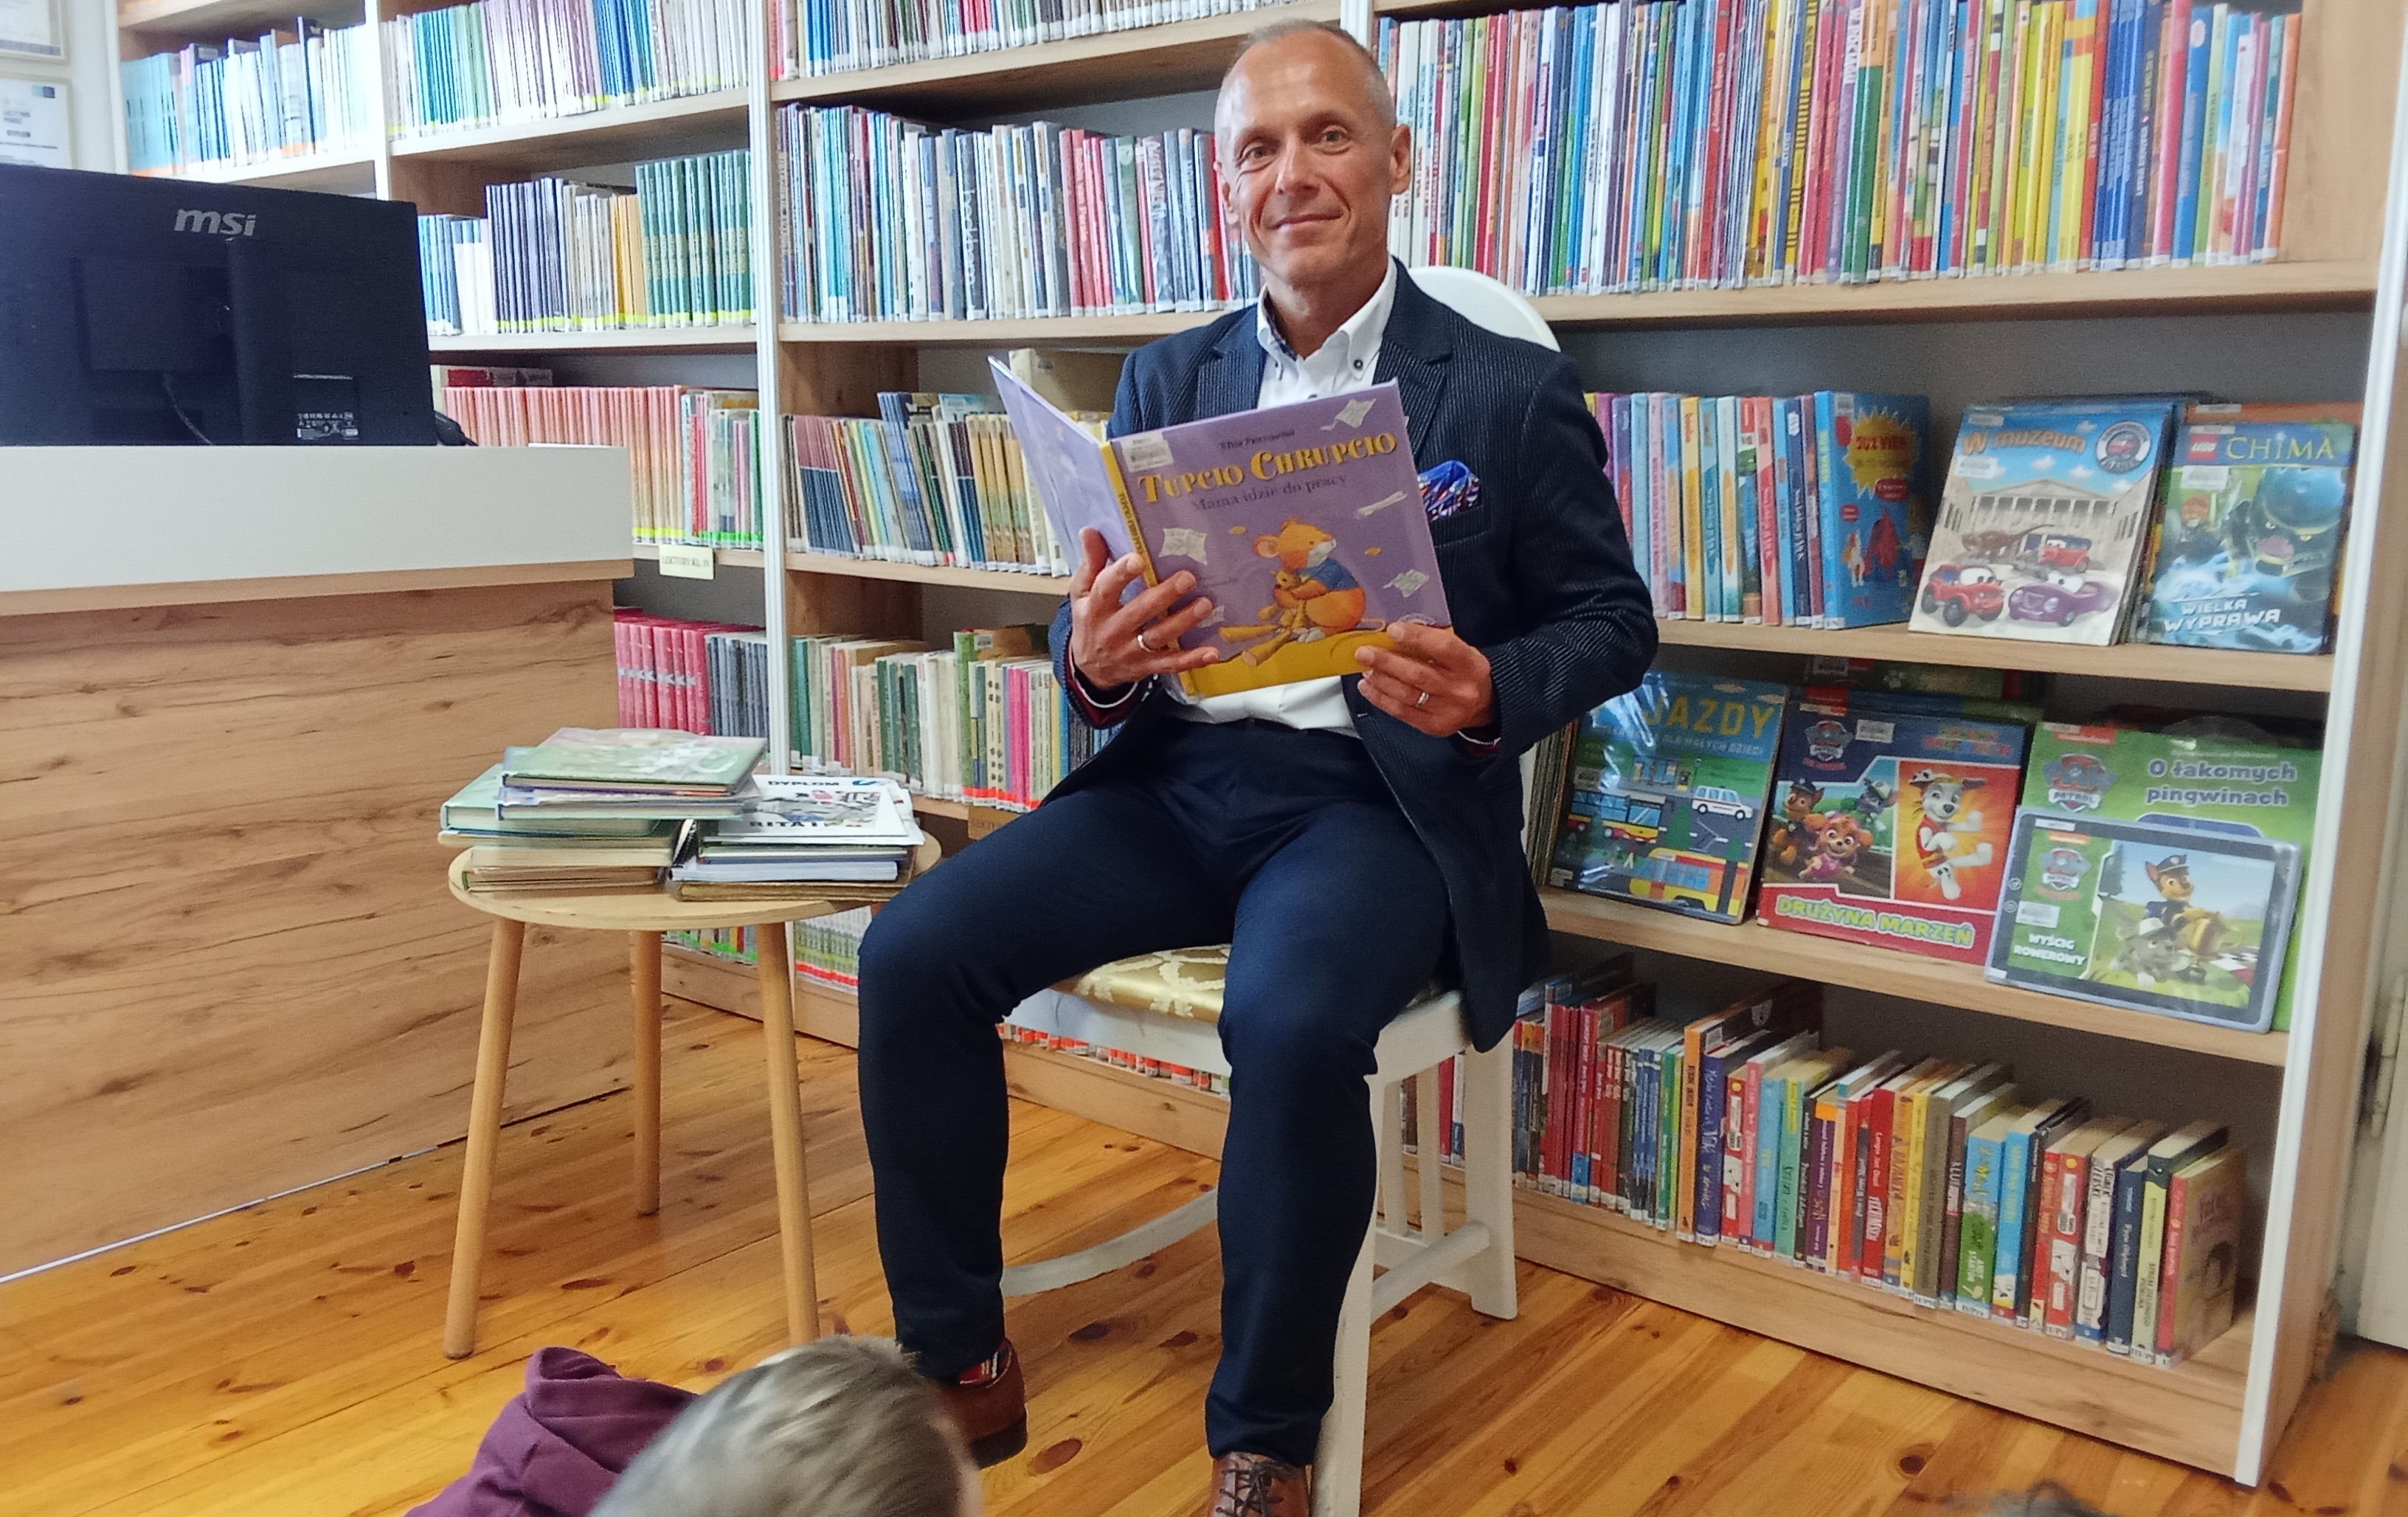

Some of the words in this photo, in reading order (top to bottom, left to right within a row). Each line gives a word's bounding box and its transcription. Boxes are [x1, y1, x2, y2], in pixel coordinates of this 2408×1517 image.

[174, 207, 256, 238] msi
[1993, 429, 2087, 455] muzeum
[2227, 435, 2335, 460] CHIMA
[1138, 464, 1245, 503] TUPCIO
[1250, 432, 1397, 480] CHRUPCIO
[1283, 483, 1305, 497] do
[2182, 599, 2248, 615] WIELKA
[2164, 609, 2281, 632] WYPRAWA
[1641, 696, 1775, 739] JAZDY
[2149, 758, 2167, 777] O
[2172, 760, 2297, 783] łakomych
[2146, 786, 2288, 806] pingwinach
[1776, 895, 1875, 930] DRUŻYNA
[1878, 913, 1975, 948] MARZEŃ
